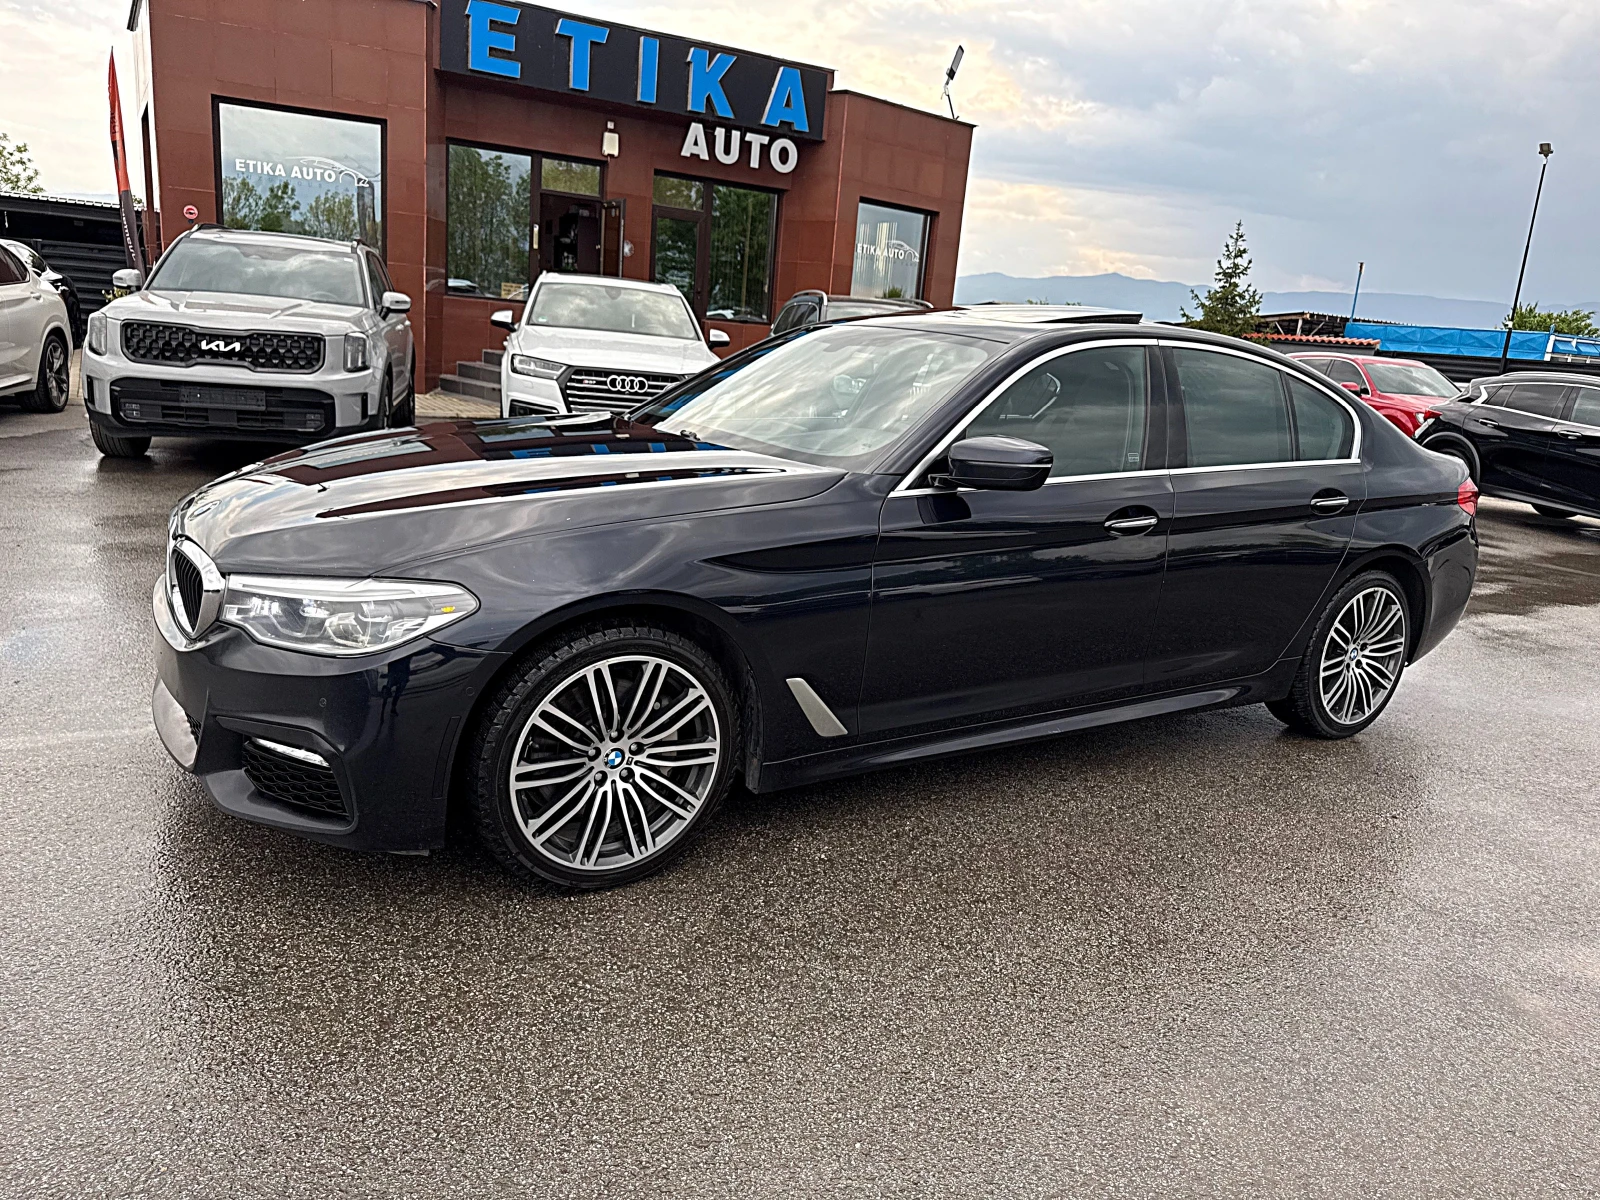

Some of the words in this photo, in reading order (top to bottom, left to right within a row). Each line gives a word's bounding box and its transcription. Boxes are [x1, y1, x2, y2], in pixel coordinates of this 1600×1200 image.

[465, 0, 810, 132] ETIKA
[681, 122, 798, 173] AUTO
[235, 158, 286, 177] ETIKA
[290, 165, 336, 183] AUTO
[857, 243, 882, 256] ETIKA
[882, 247, 905, 260] AUTO
